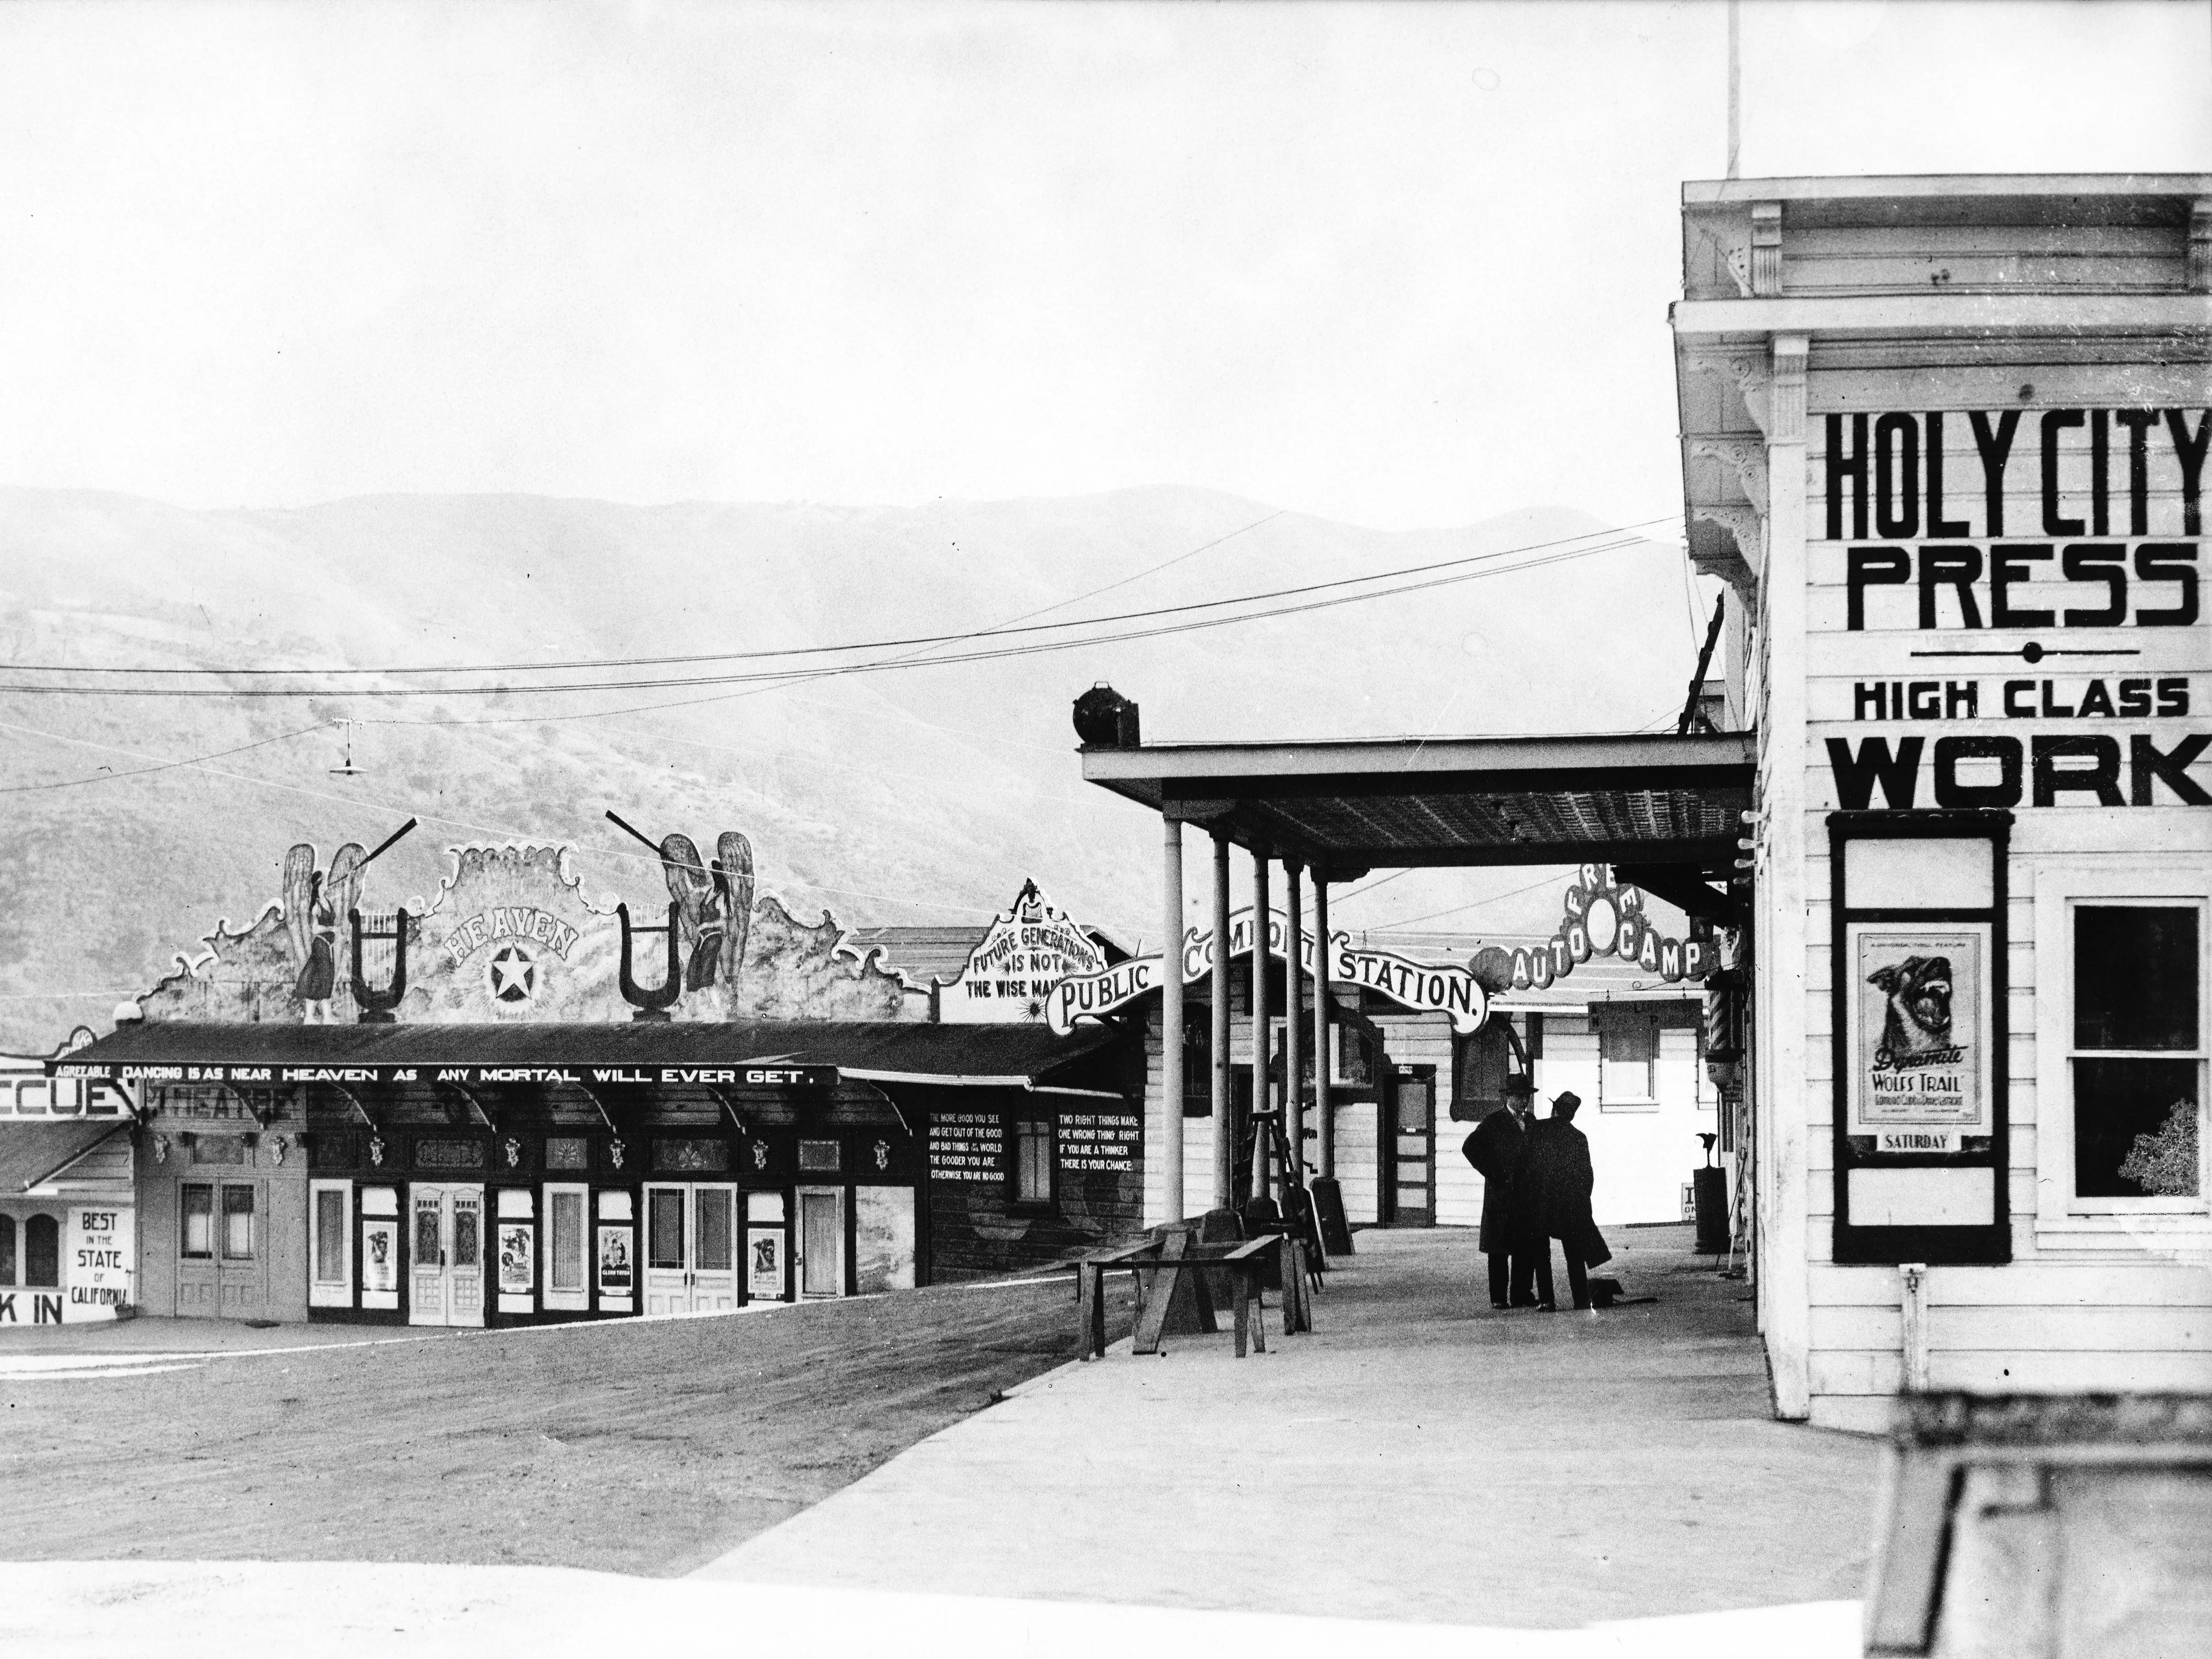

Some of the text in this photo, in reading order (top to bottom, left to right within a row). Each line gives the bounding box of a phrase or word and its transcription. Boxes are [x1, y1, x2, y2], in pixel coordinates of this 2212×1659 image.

[1826, 408, 2212, 540] HOLY CITY
[1848, 543, 2199, 631] PRESS
[1855, 678, 2189, 720] HIGH CLASS
[1825, 734, 2212, 810] WORK
[1568, 863, 1637, 913] FREE
[444, 908, 578, 968] HEAVEN
[974, 927, 1095, 975] FUTURE GENERATIONS
[1513, 923, 1700, 982] AUTO CAMP
[1012, 954, 1061, 973] IS NOT
[966, 980, 991, 1000] THE
[996, 980, 1027, 998] WISE
[1061, 965, 1150, 1028] PUBLIC
[1338, 954, 1478, 1016] STATION.
[55, 1065, 111, 1078] AGREEABLE
[123, 1066, 182, 1079] DANCING
[188, 1067, 200, 1079] IS
[203, 1067, 223, 1080] AS
[231, 1068, 271, 1080] NEAR
[283, 1069, 378, 1081] HEAVEN
[393, 1069, 417, 1081] AS
[437, 1069, 469, 1081] ANY
[480, 1069, 580, 1082] MORTAL
[593, 1069, 652, 1082] WILL
[662, 1070, 735, 1083] EVER
[930, 1113, 999, 1123] THE MORE GOOD YOU SEE
[1059, 1114, 1138, 1126] TWO RIGHT THINGS MAKE
[930, 1127, 1002, 1138] AND GET OUT OF THE GOOD
[1058, 1129, 1139, 1140] ONE WRONG THING RIGHT
[930, 1142, 939, 1150] AND
[941, 1142, 951, 1151] BAD
[952, 1142, 969, 1151] THINGS
[980, 1143, 1002, 1152] WORLD
[1060, 1144, 1128, 1155] IF YOU ARE A THINKER
[1886, 1135, 1947, 1149] SATURDAY
[930, 1155, 995, 1166] THE GOODER YOU ARE
[1060, 1159, 1079, 1169] THERE
[1082, 1159, 1087, 1169] IS
[1088, 1159, 1105, 1169] YOUR
[931, 1169, 1004, 1181] OTHERWISE YOU ARE NO GOOD
[83, 1213, 117, 1230] BEST
[86, 1236, 113, 1245] IN THE
[78, 1250, 121, 1268] STATE
[94, 1273, 104, 1282] OF
[34, 1295, 62, 1324] IN
